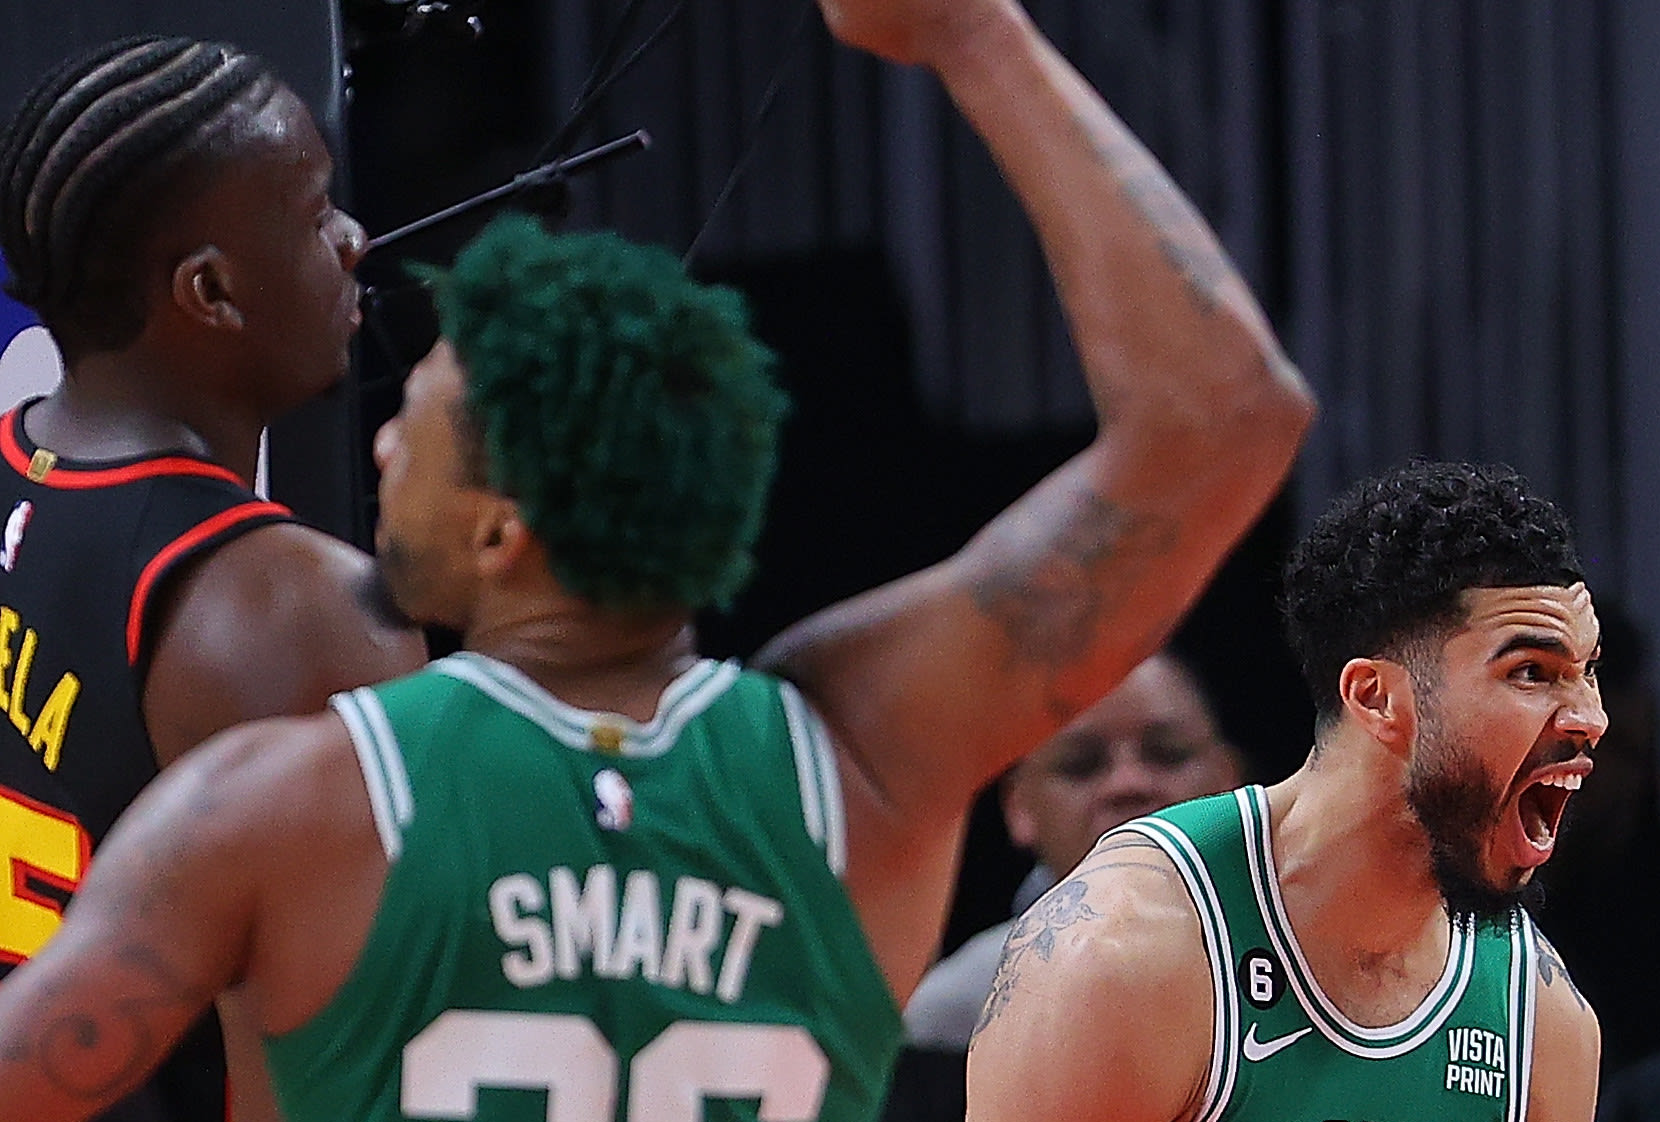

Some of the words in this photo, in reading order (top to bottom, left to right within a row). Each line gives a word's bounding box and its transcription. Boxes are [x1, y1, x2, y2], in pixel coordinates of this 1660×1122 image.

[488, 863, 784, 1004] SMART
[1250, 957, 1273, 1002] 6
[1448, 1027, 1506, 1072] VISTA
[1446, 1063, 1505, 1098] PRINT
